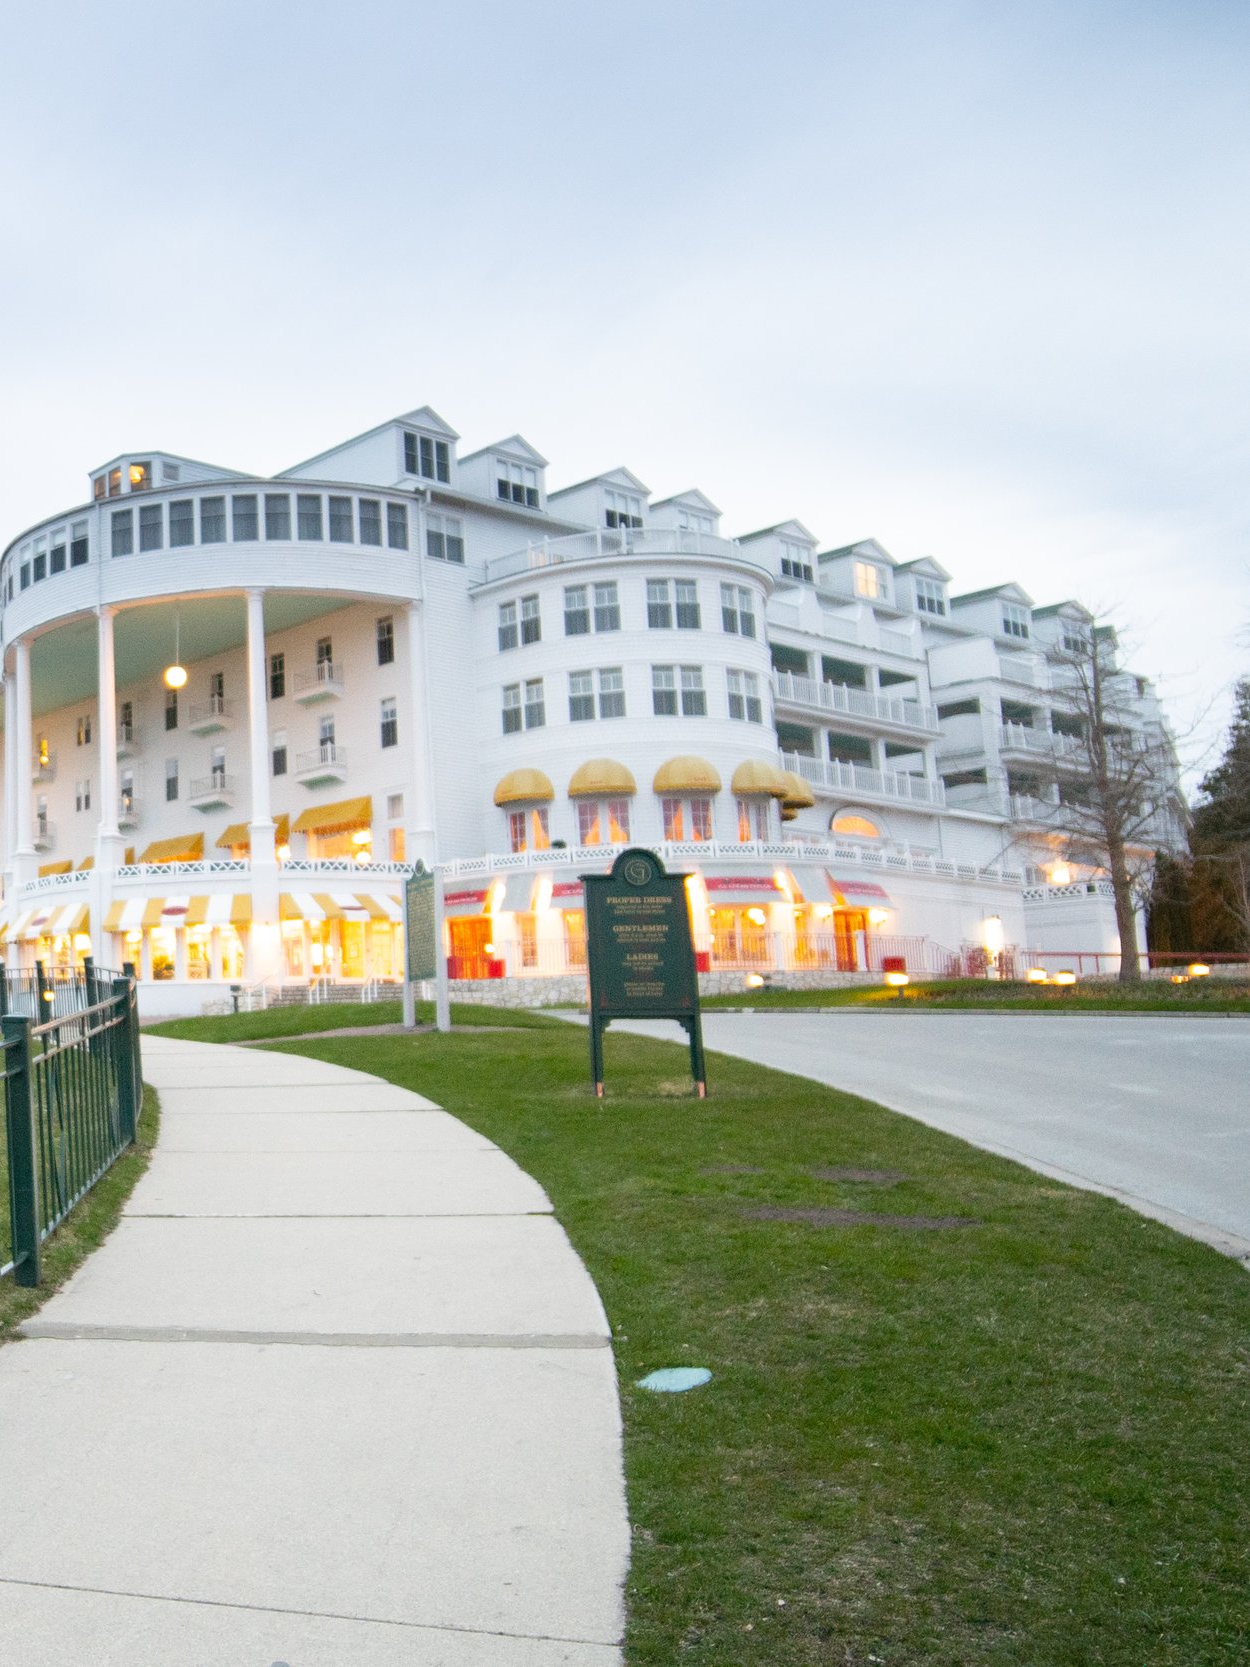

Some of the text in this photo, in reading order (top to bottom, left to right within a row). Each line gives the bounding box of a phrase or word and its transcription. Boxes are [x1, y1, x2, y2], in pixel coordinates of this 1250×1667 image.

[606, 896, 672, 904] PROPER DRESS
[612, 924, 669, 932] GENTLEMEN
[626, 953, 659, 961] LADIES
